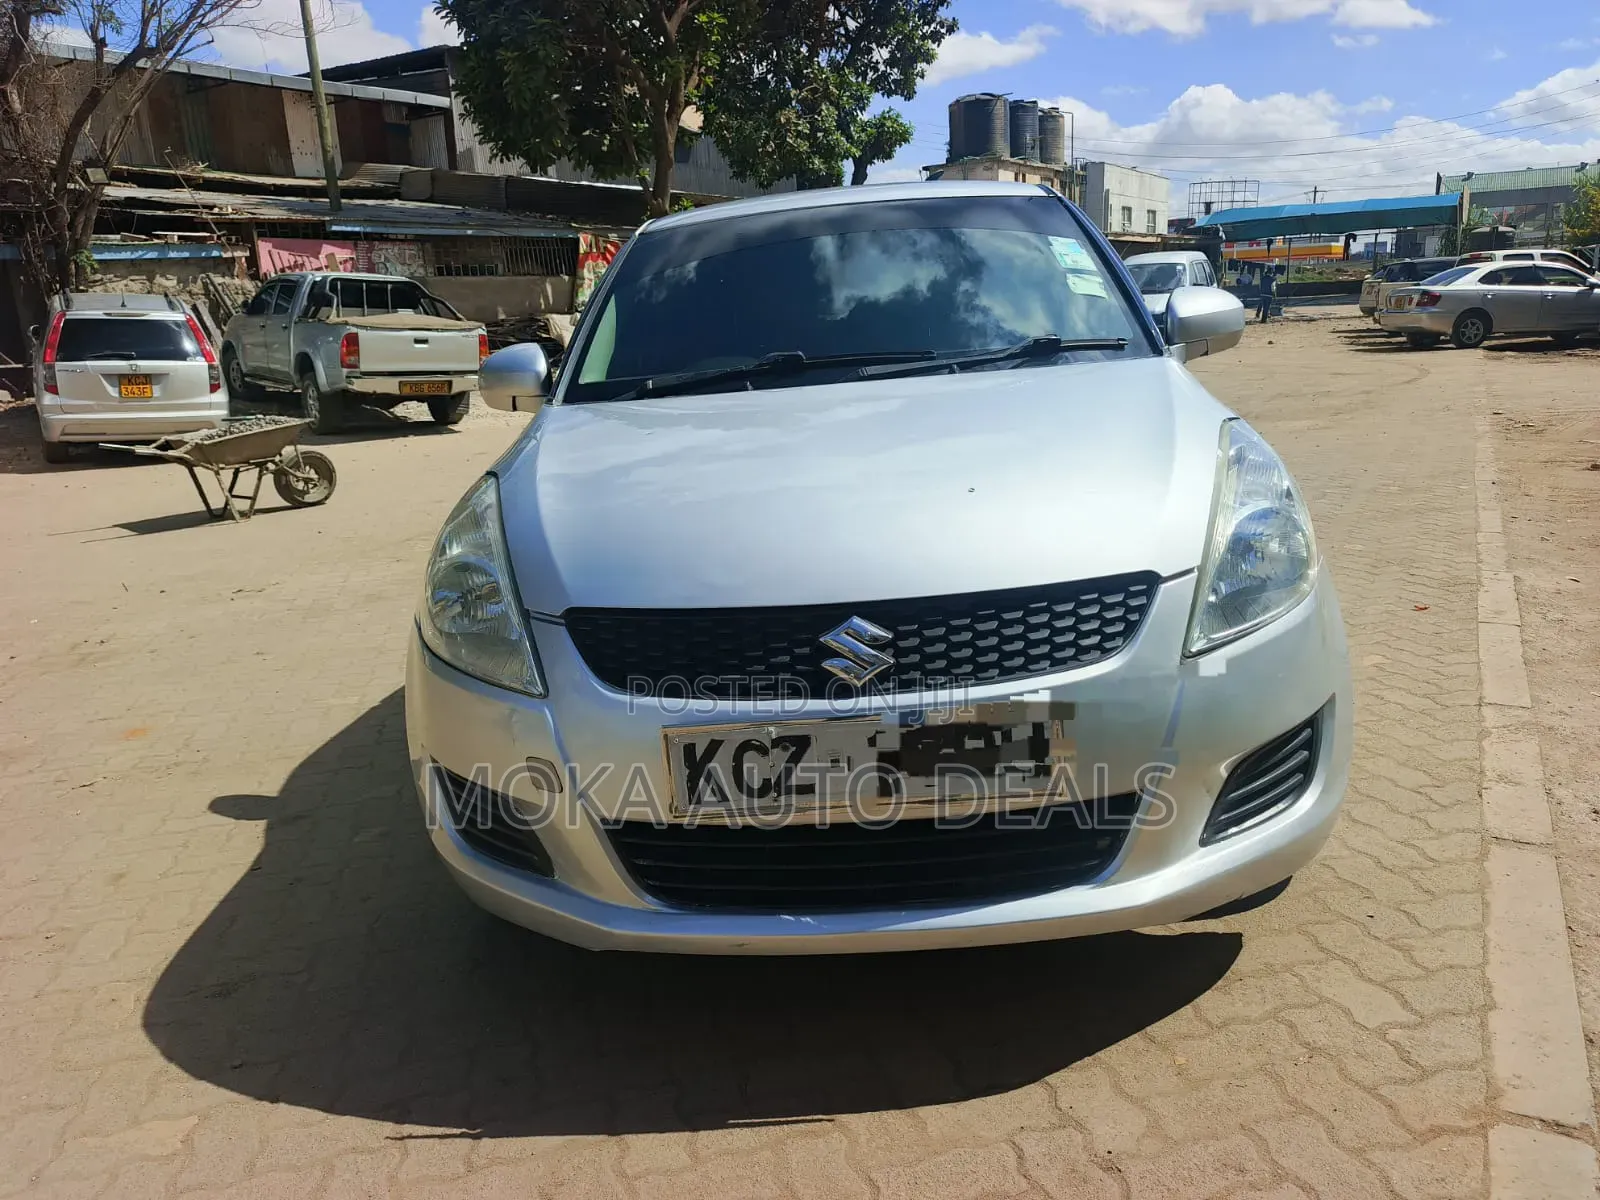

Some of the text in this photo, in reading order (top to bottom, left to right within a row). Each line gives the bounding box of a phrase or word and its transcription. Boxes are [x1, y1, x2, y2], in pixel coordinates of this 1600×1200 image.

[128, 376, 148, 385] KCJ
[123, 387, 148, 396] 343F
[682, 733, 816, 806] KCZ
